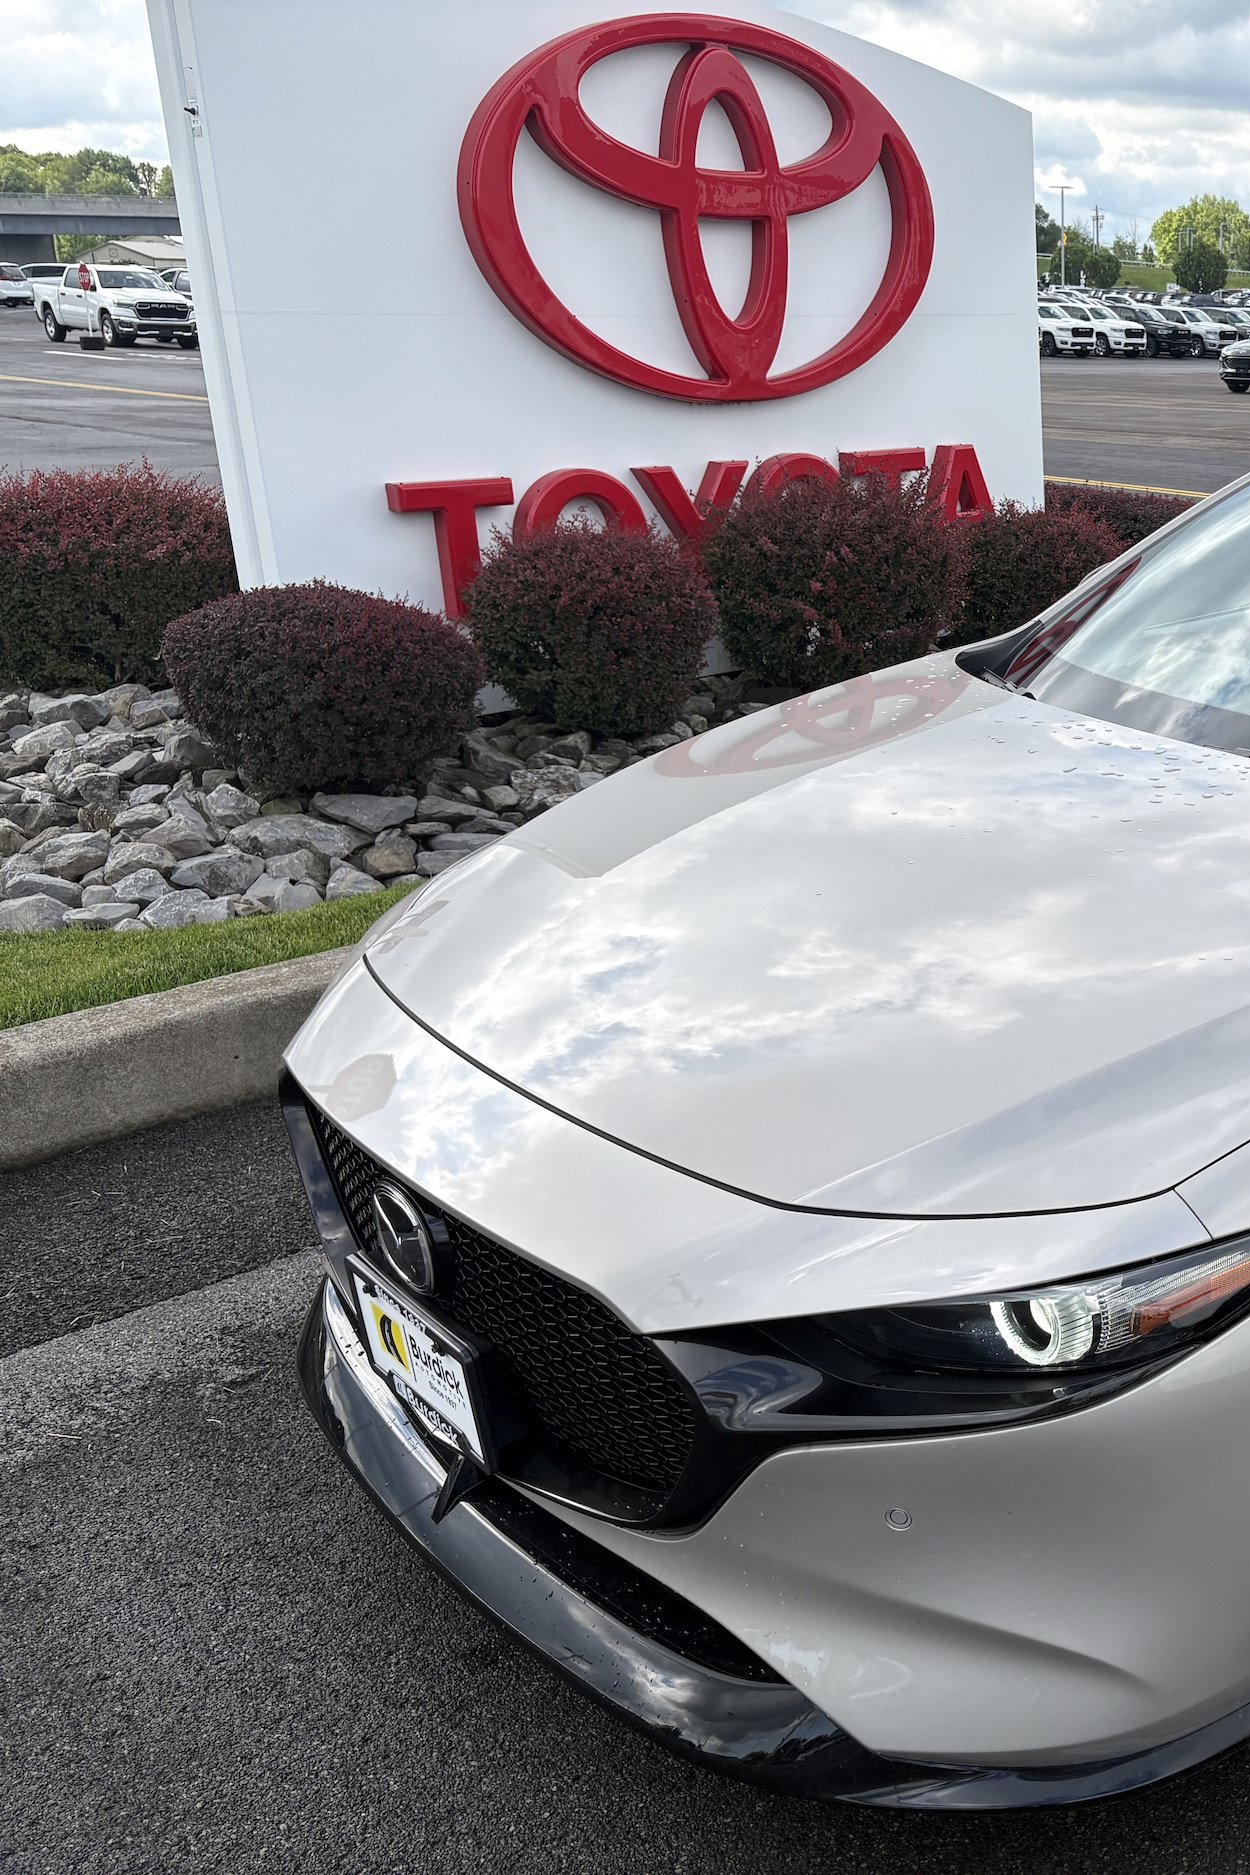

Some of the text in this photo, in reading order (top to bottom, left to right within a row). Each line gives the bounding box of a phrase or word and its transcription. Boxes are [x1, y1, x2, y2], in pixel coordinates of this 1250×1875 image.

[385, 443, 995, 622] TOYA
[409, 1334, 463, 1399] Burdick
[406, 1386, 460, 1448] Burdick
